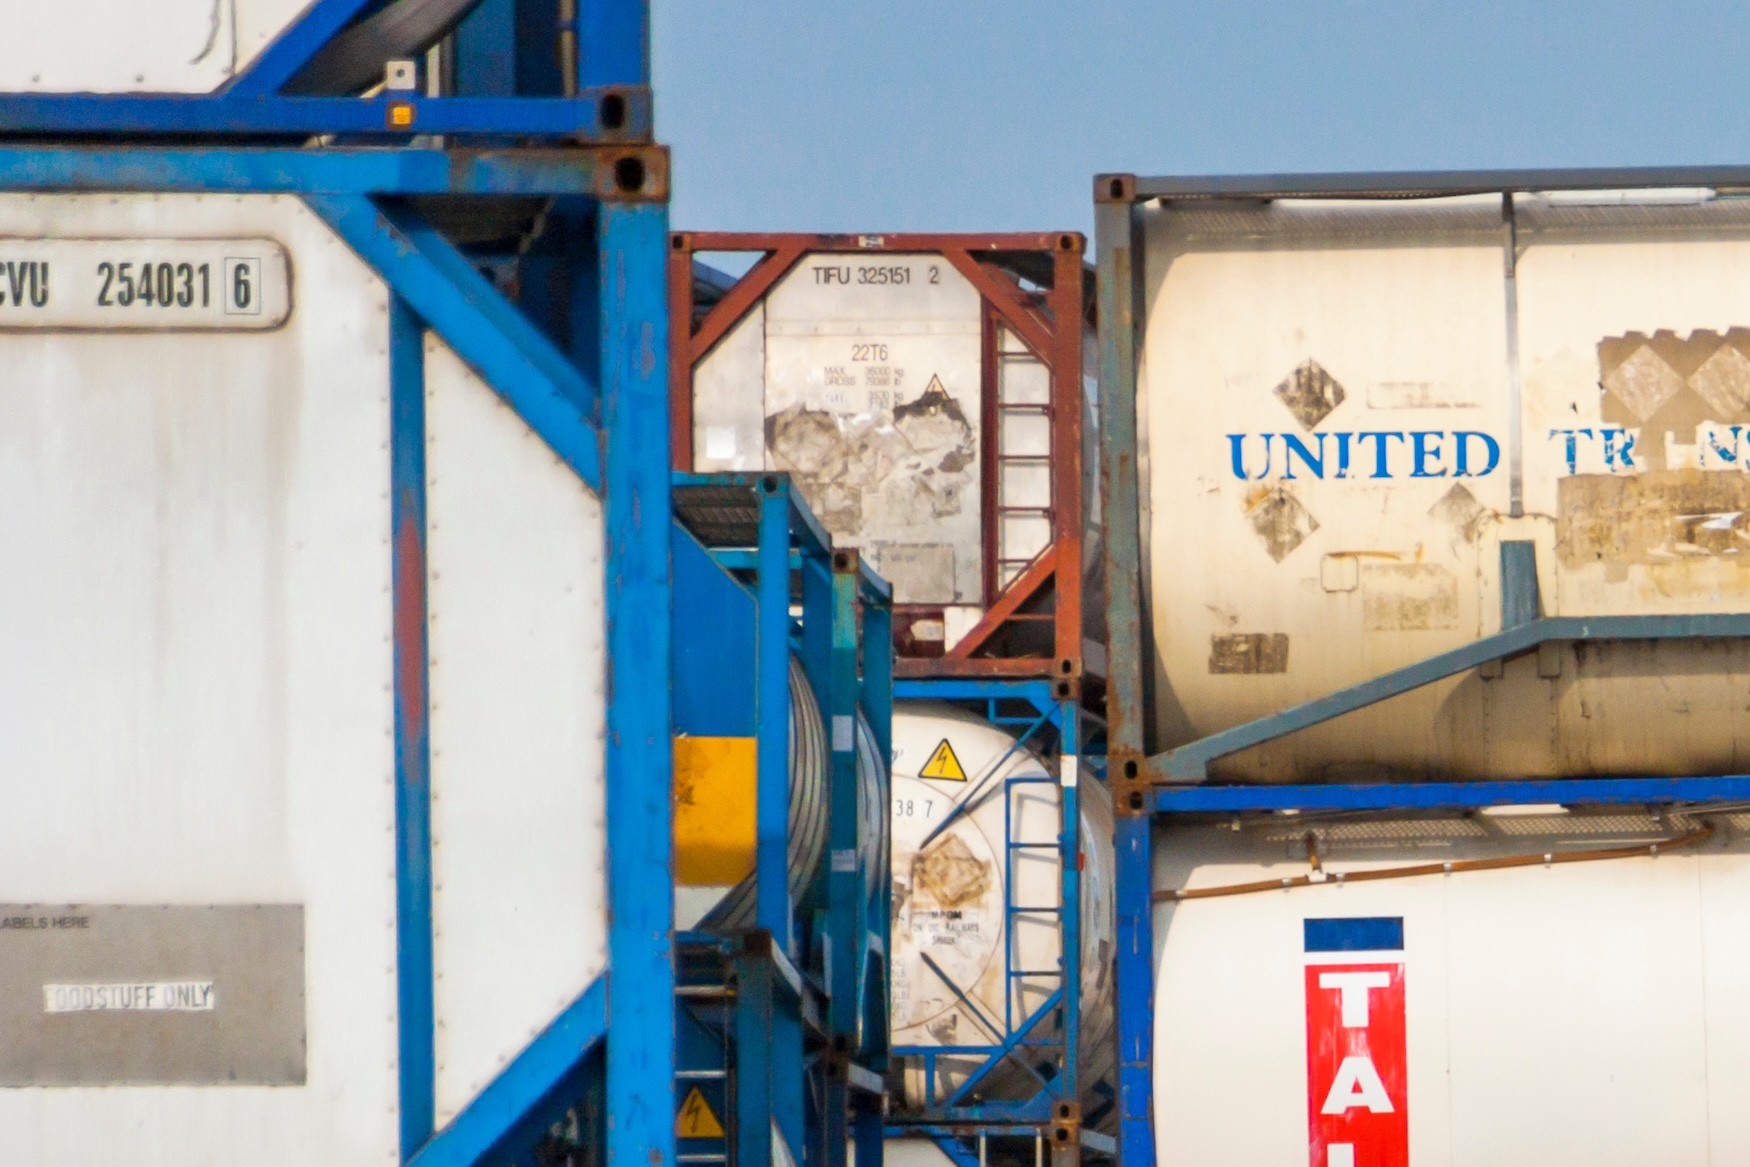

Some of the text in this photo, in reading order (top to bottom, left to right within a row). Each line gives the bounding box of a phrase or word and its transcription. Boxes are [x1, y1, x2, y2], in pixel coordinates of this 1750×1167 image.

[812, 265, 939, 285] TIFU 325151 2
[0, 261, 251, 309] VU 254031 6
[852, 344, 888, 361] 22T6
[1226, 430, 1502, 480] UNITED
[896, 800, 933, 818] 38 7
[52, 916, 90, 928] HERE
